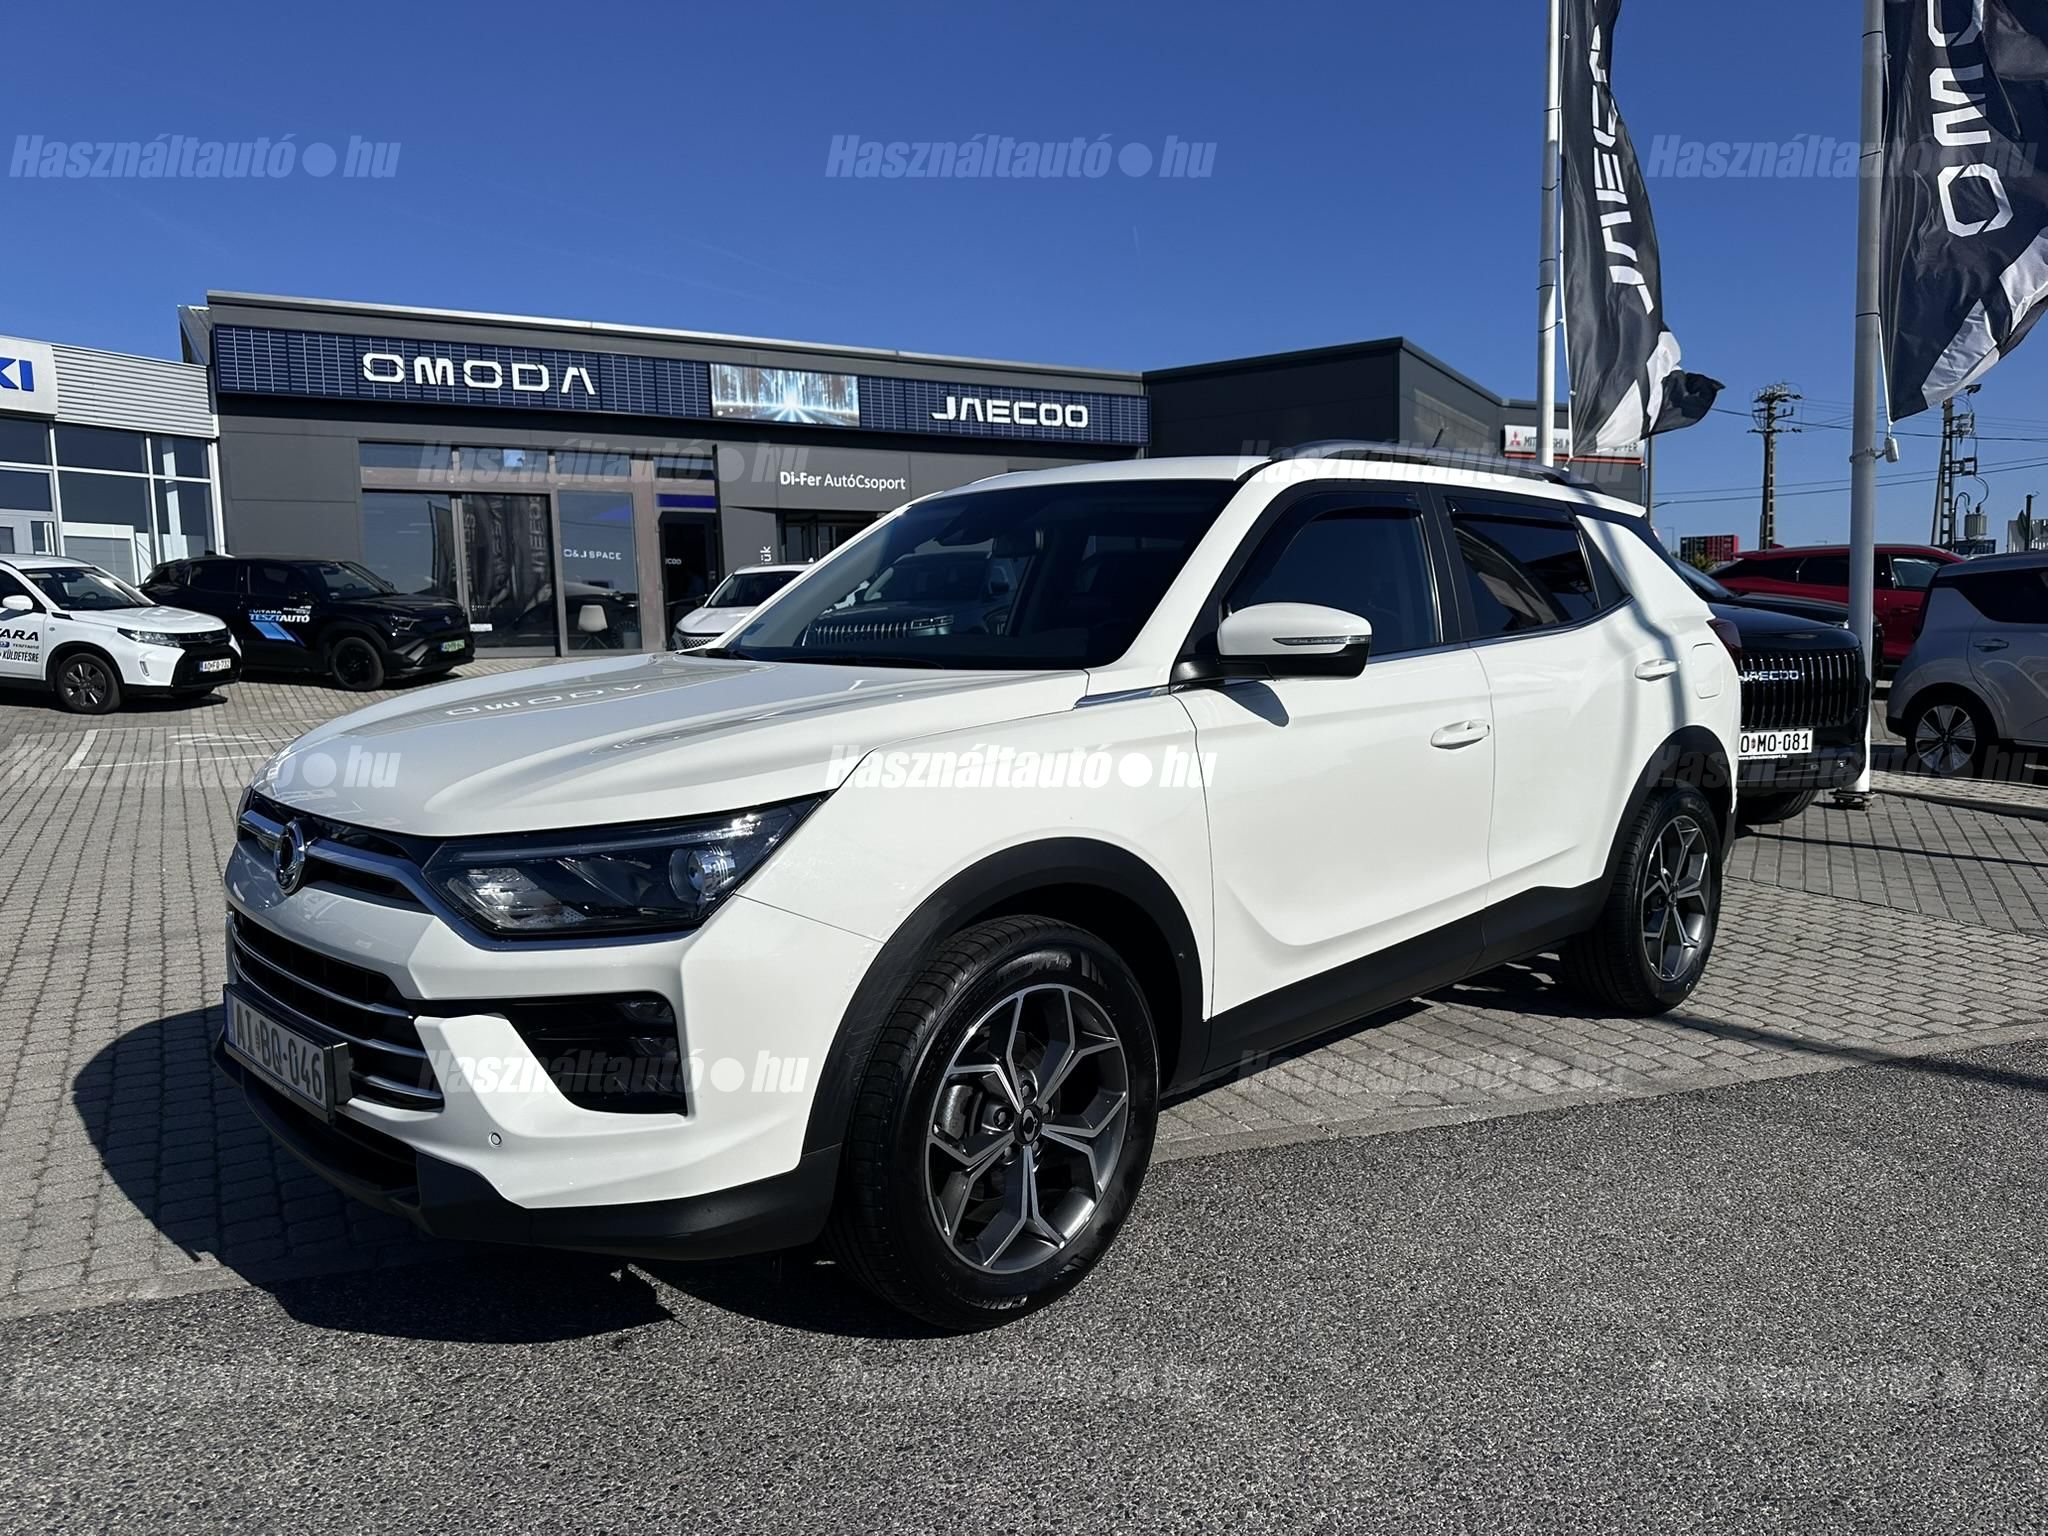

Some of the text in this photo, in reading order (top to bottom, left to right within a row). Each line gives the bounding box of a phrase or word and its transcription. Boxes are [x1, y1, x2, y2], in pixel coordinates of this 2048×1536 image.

[362, 352, 597, 396] OMODA
[931, 396, 1089, 429] JAECOO
[780, 471, 906, 492] Di-Fer AutóCsoport
[588, 551, 623, 561] SPACE
[0, 627, 39, 642] ARA
